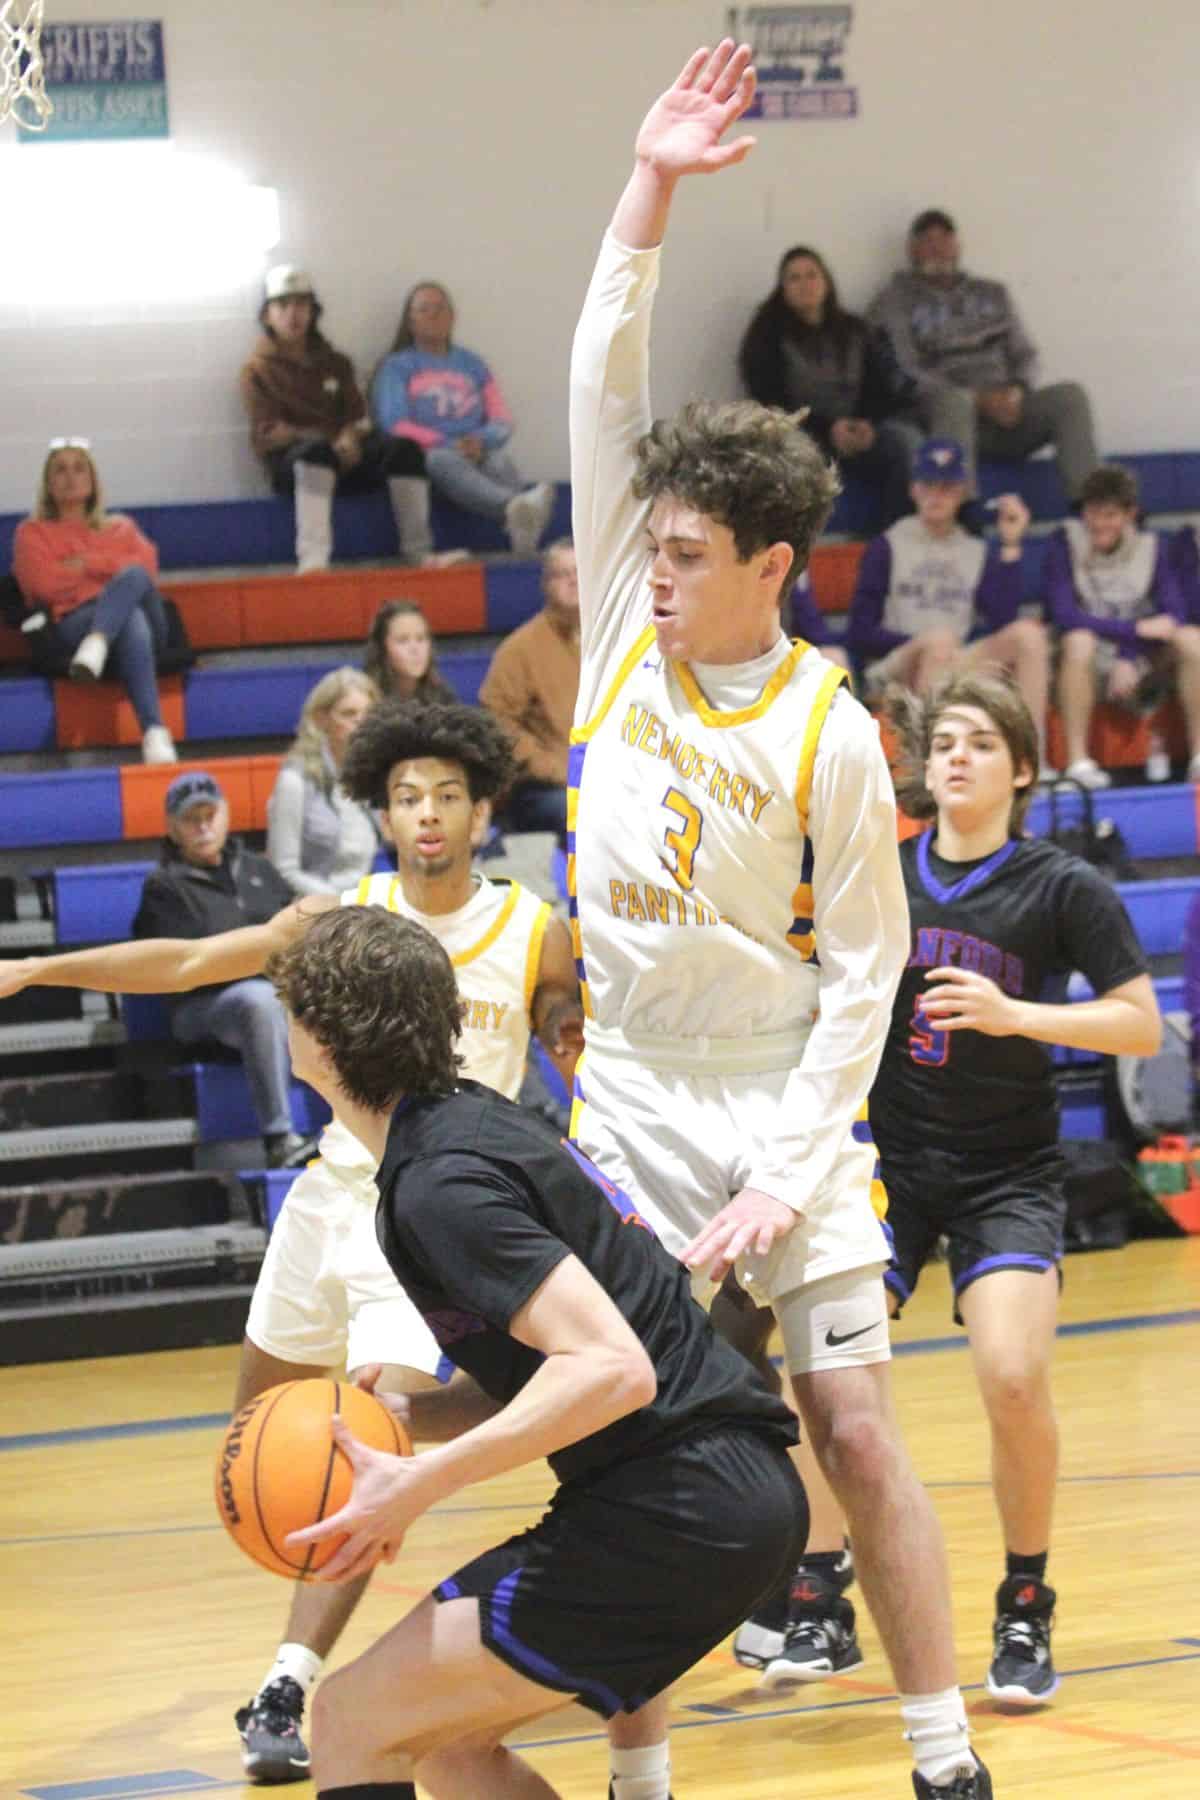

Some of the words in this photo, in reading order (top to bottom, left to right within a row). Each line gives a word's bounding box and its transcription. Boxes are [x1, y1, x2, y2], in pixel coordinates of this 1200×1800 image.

[661, 785, 704, 892] 3
[609, 879, 737, 929] PANT
[909, 927, 1025, 995] NFORD
